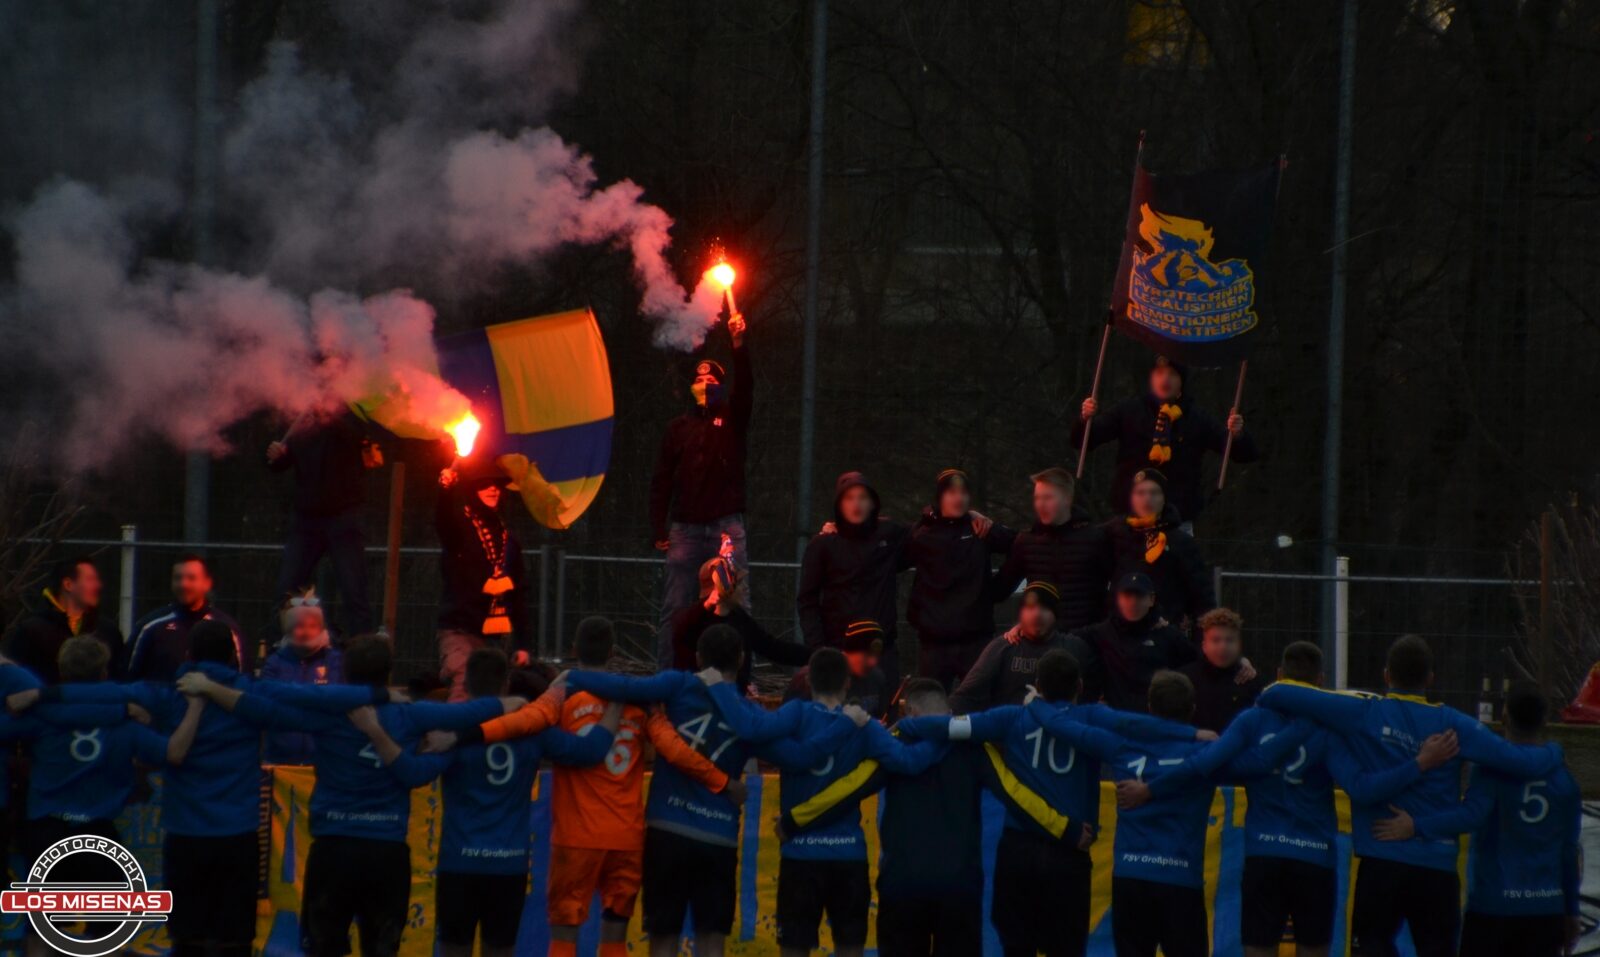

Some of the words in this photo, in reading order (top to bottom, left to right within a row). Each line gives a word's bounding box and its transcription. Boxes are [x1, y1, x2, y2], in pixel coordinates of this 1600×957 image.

[485, 741, 516, 787] 9
[1025, 726, 1077, 775] 10
[1519, 780, 1550, 824] 5
